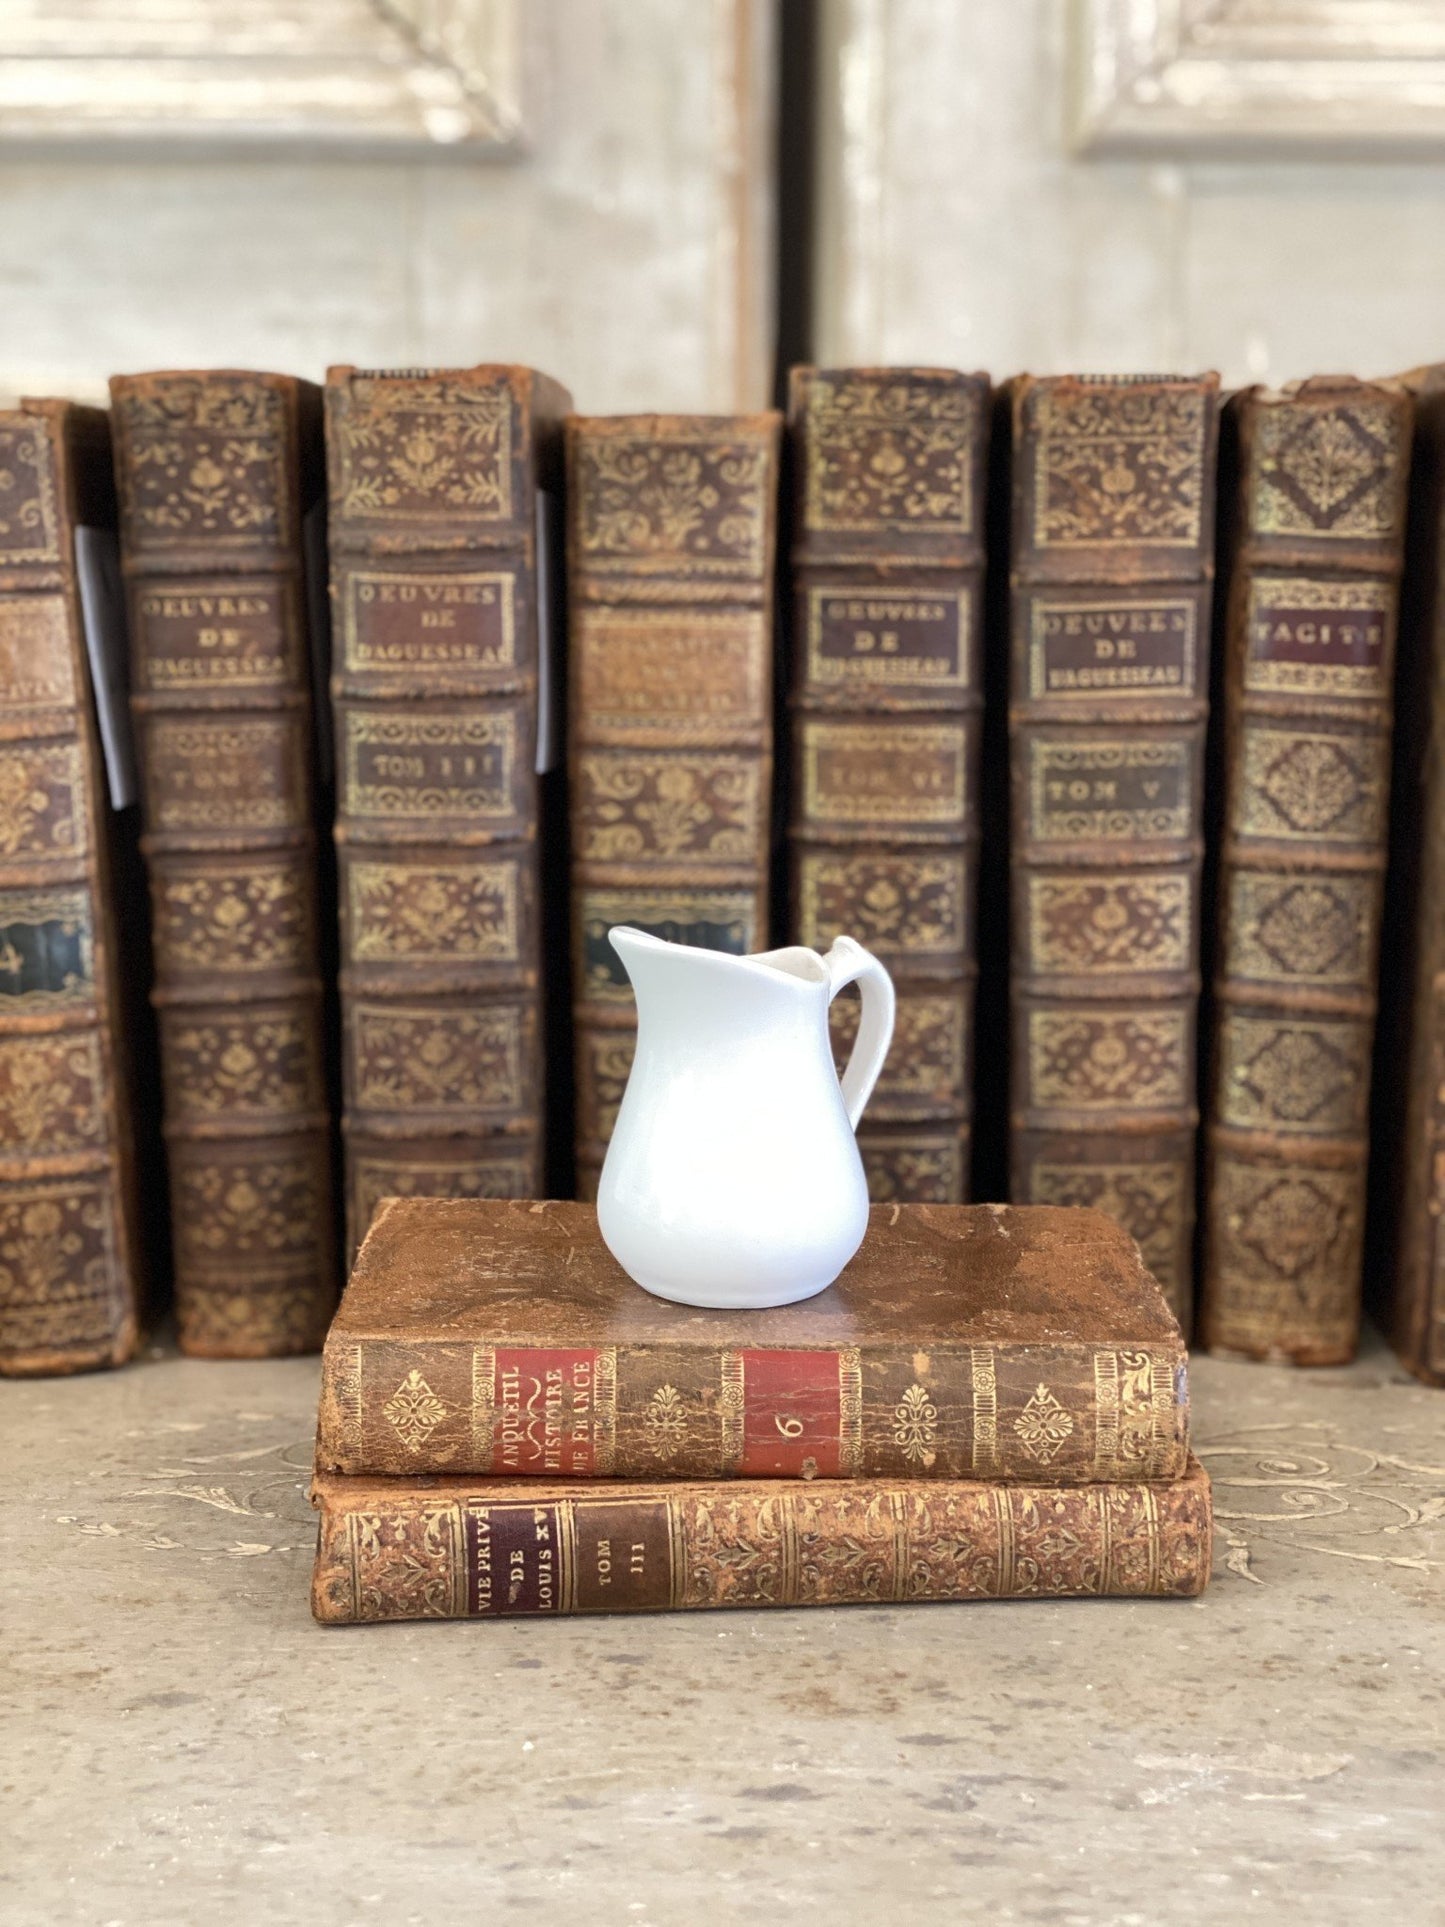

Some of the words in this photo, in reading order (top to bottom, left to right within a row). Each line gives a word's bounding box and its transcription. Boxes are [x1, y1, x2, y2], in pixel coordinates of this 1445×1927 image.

[359, 584, 496, 604] OEUVRES
[142, 597, 270, 618] OEUVRES
[420, 610, 456, 628] DE
[828, 601, 946, 621] OEUVRES
[1043, 613, 1186, 635] OEUVRES
[198, 628, 241, 648] DE
[854, 630, 899, 652] DE
[1095, 638, 1138, 659] DE
[373, 754, 424, 778] TOM
[831, 769, 889, 787] TOM
[1048, 780, 1118, 801] TOM
[1143, 782, 1161, 800] V
[572, 1362, 590, 1442] FRANCE
[501, 1366, 524, 1466] ANQUETIL
[545, 1369, 563, 1468] HISTOIRE
[775, 1415, 804, 1438] 6
[534, 1507, 550, 1541] XV
[510, 1549, 525, 1582] DE
[597, 1540, 612, 1586] TOM
[630, 1542, 646, 1574] III
[538, 1549, 553, 1609] LOUIS
[478, 1577, 493, 1611] VIE
